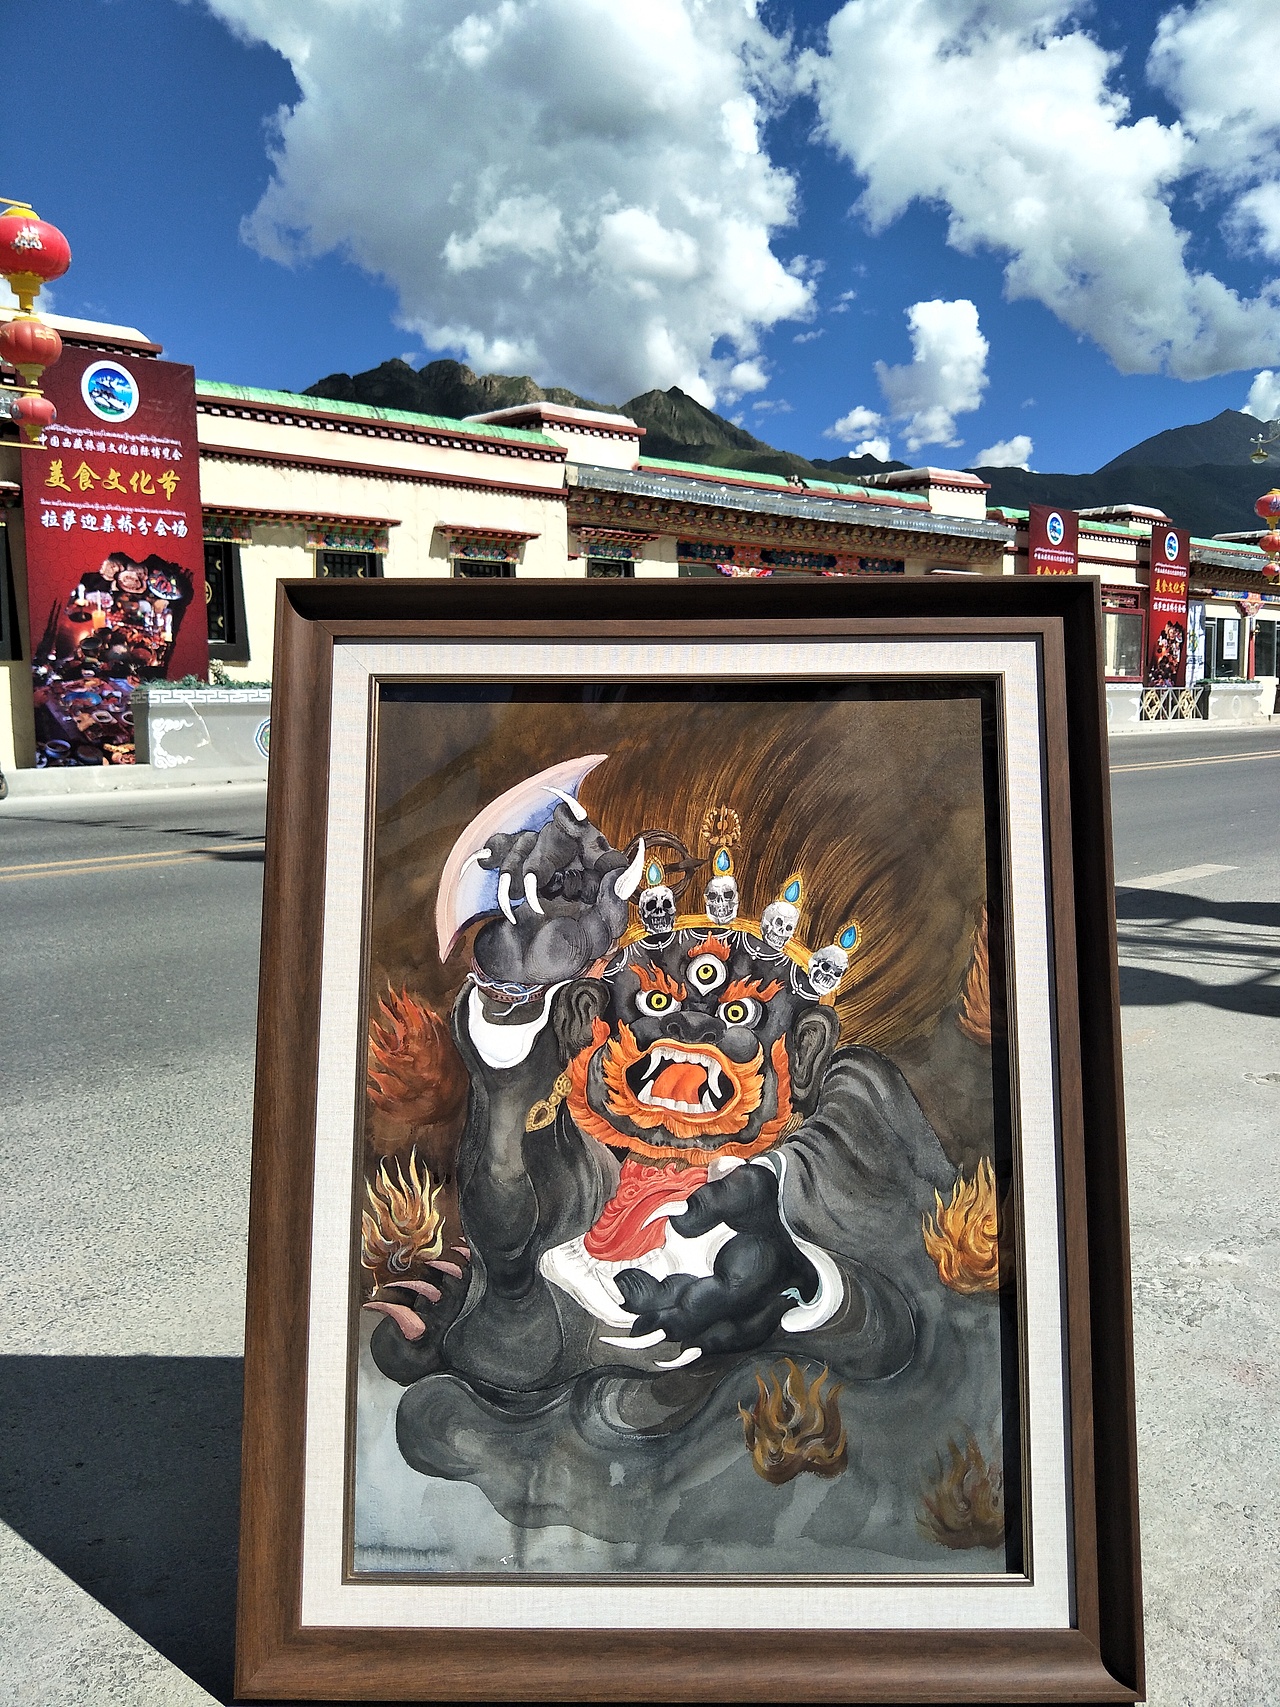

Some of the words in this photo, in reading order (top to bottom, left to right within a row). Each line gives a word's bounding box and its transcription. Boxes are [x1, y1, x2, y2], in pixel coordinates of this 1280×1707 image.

[38, 433, 183, 461] 中国西藏旅游文化国际博览会
[44, 459, 181, 501] 美食文化节
